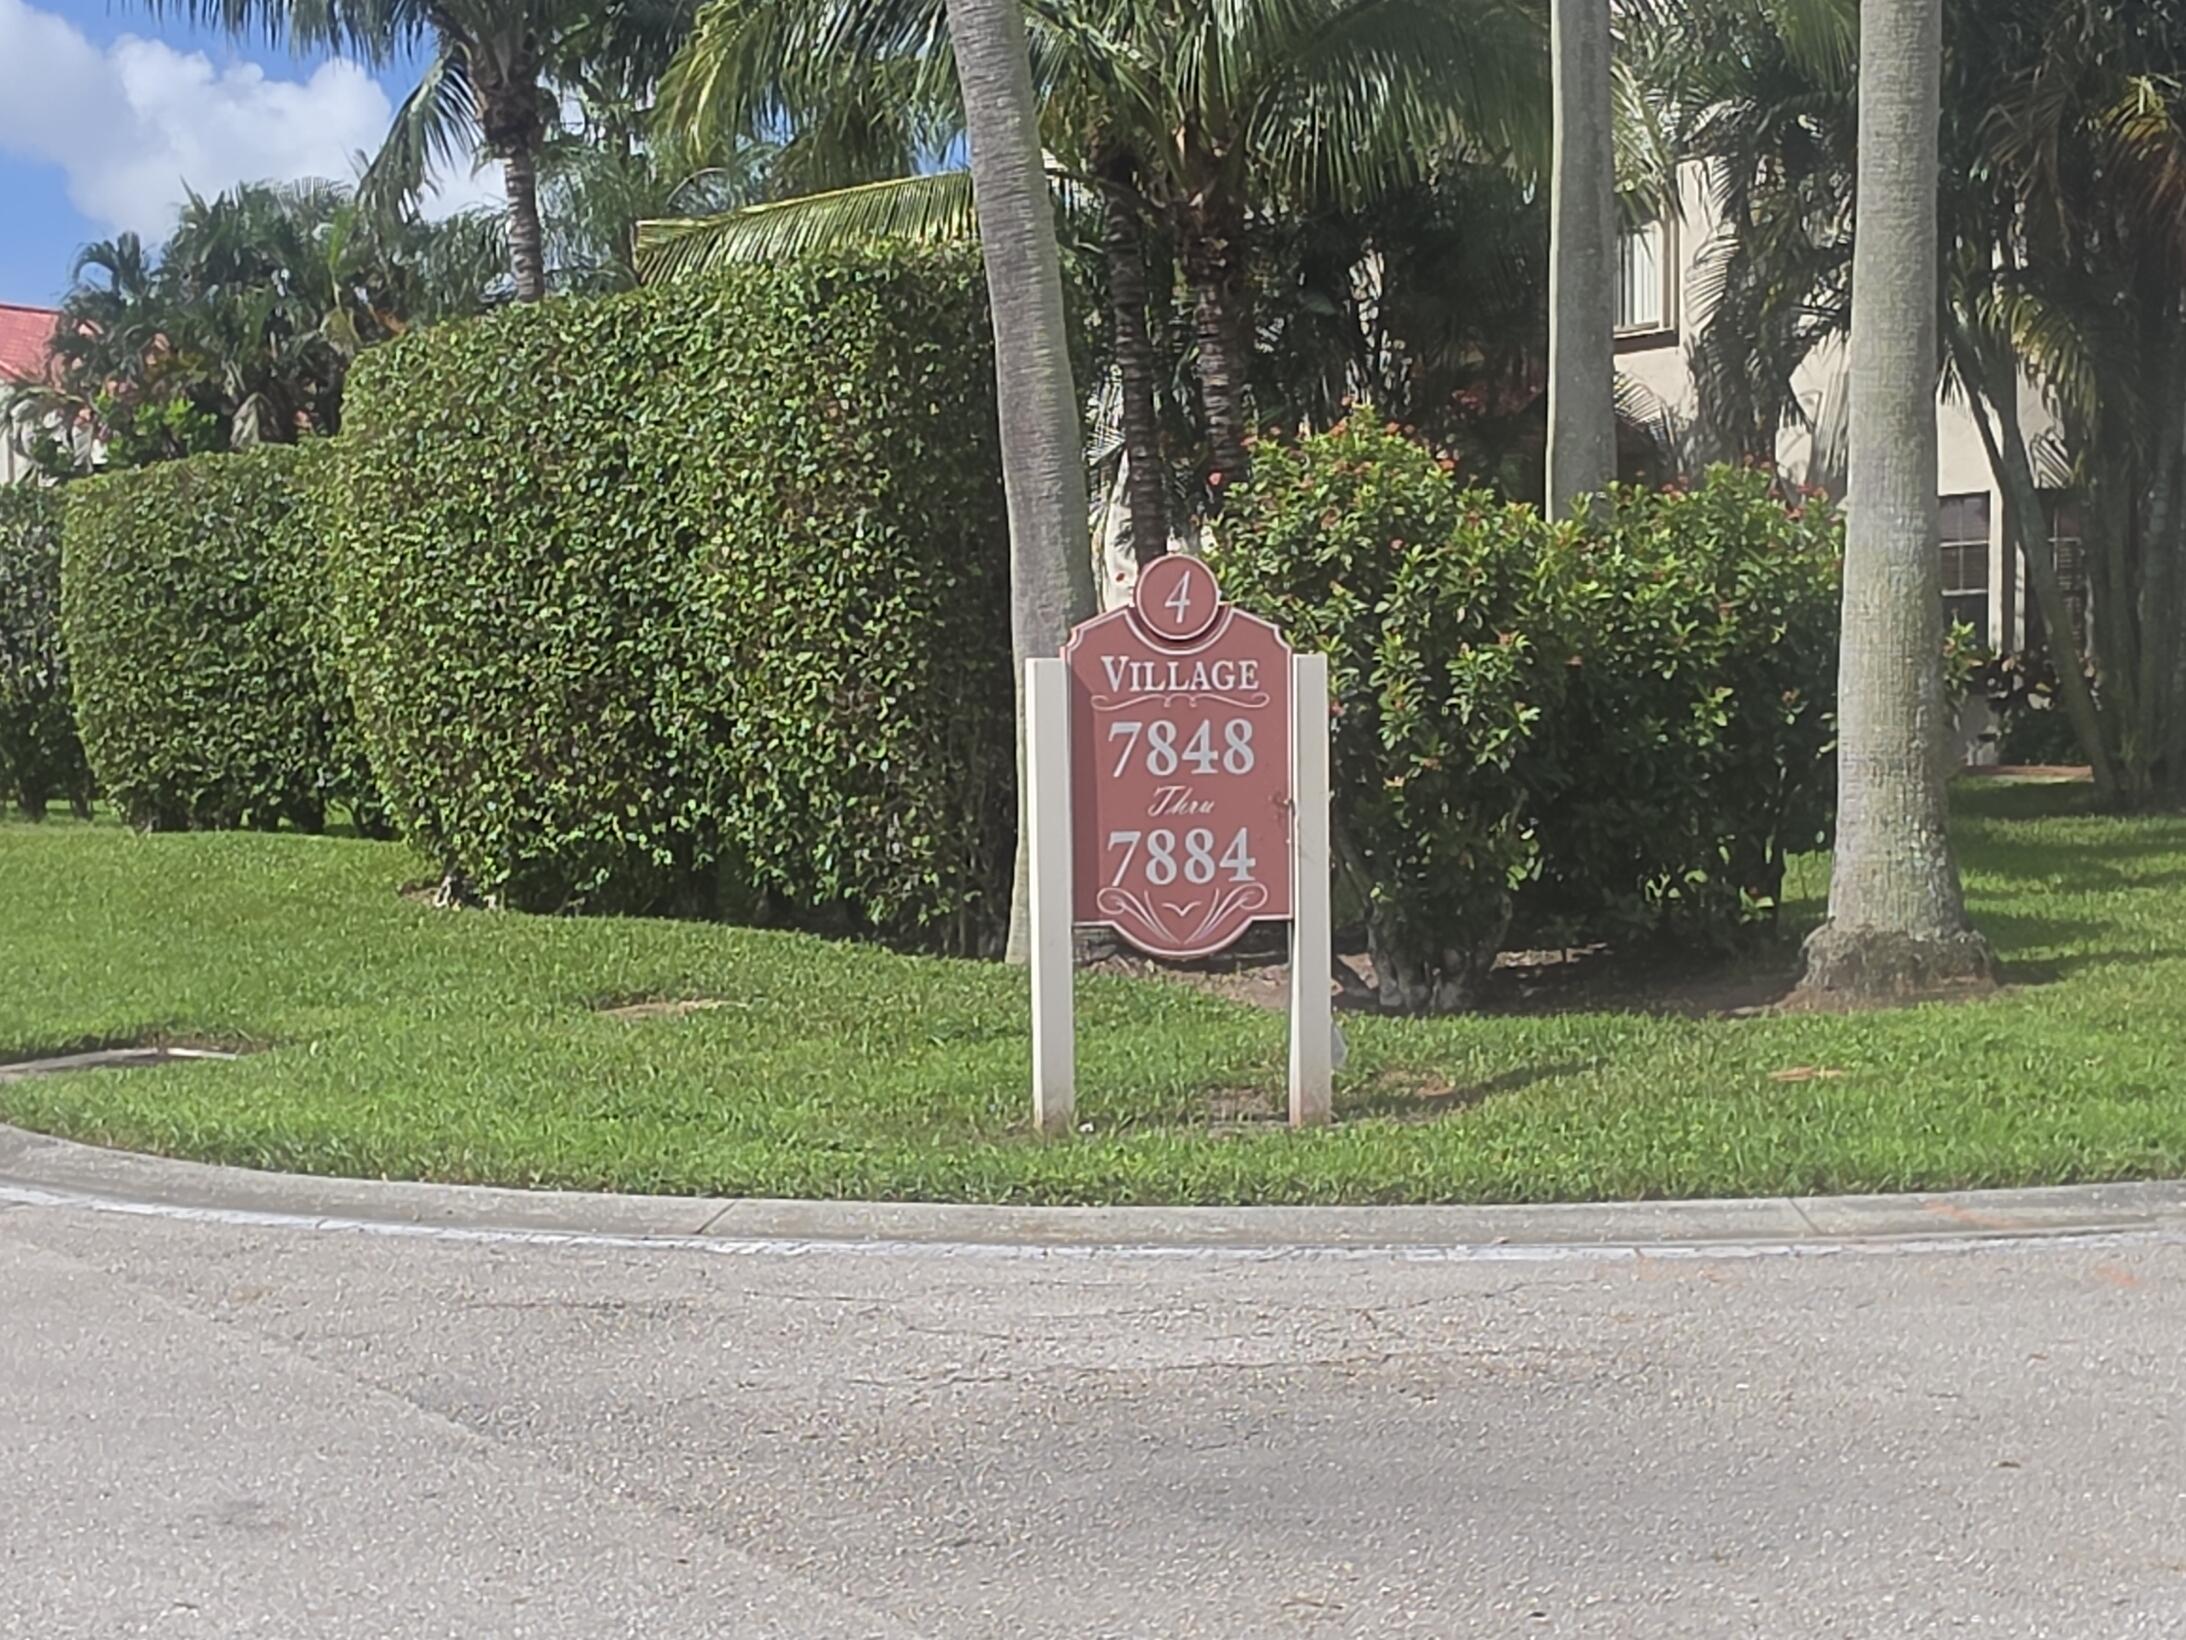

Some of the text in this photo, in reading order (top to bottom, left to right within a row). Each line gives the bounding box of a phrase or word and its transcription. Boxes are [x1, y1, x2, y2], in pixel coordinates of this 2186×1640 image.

[1164, 569, 1191, 624] 4
[1101, 656, 1260, 692] VILLAGE
[1107, 718, 1255, 778] 7848
[1147, 785, 1215, 817] Thru
[1107, 827, 1256, 887] 7884
